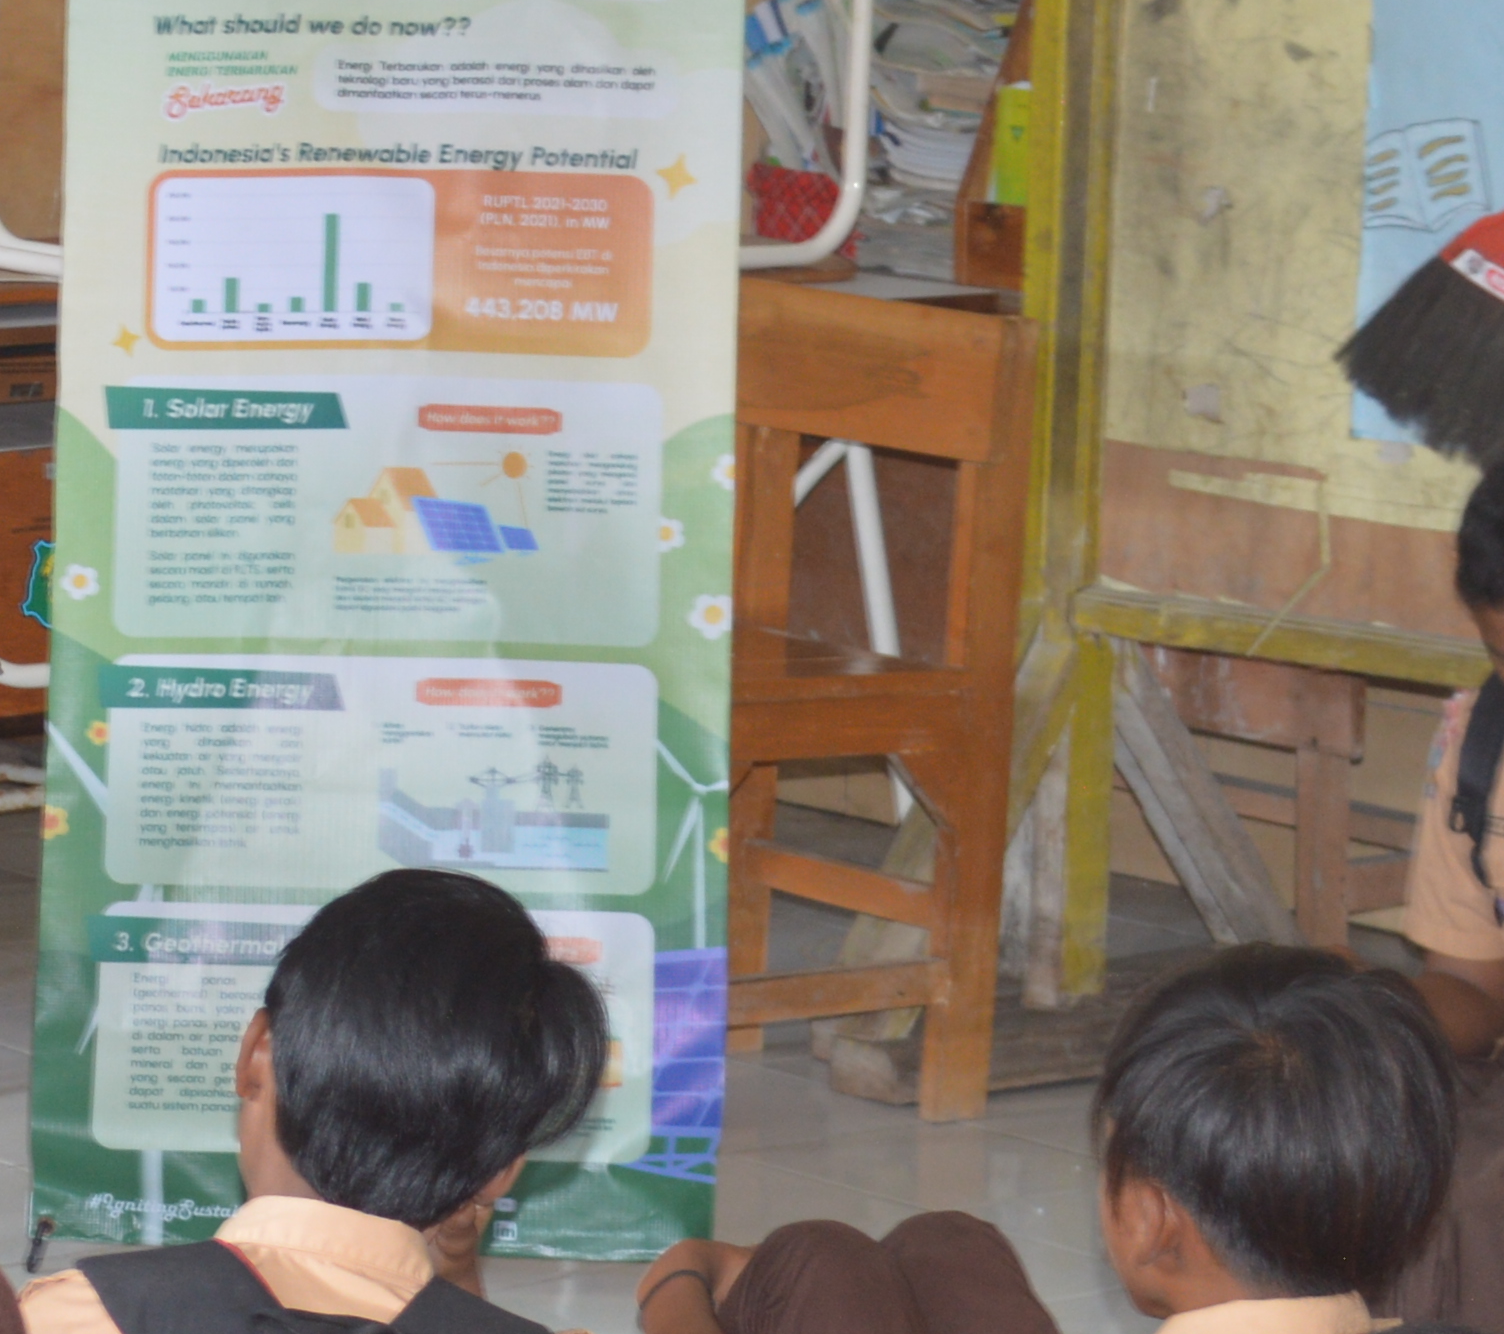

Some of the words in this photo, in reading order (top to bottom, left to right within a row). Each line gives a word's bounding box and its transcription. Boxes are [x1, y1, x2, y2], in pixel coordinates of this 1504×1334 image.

[155, 15, 216, 36] What
[222, 14, 302, 36] should
[308, 20, 344, 36] we
[351, 15, 382, 36] do
[388, 17, 472, 37] now??
[338, 59, 373, 72] Energi
[380, 60, 444, 72] Terbarukan
[160, 142, 291, 165] Indonesia's
[298, 142, 432, 164] Renewable
[437, 143, 524, 172] Energy
[531, 146, 638, 170] Potential
[571, 301, 618, 322] MW
[142, 399, 158, 418] 1.
[165, 397, 229, 419] Solar
[232, 398, 315, 424] Energy
[427, 412, 455, 425] How
[126, 677, 150, 698] 2.
[155, 677, 226, 704] Hydro
[228, 678, 315, 705] Energy
[114, 932, 134, 952] 3.
[145, 932, 285, 955] Geothermal
[147, 1030, 184, 1042] dalam
[181, 1045, 223, 1057] batuan
[129, 1072, 159, 1084] yang
[162, 1100, 199, 1111] sistem
